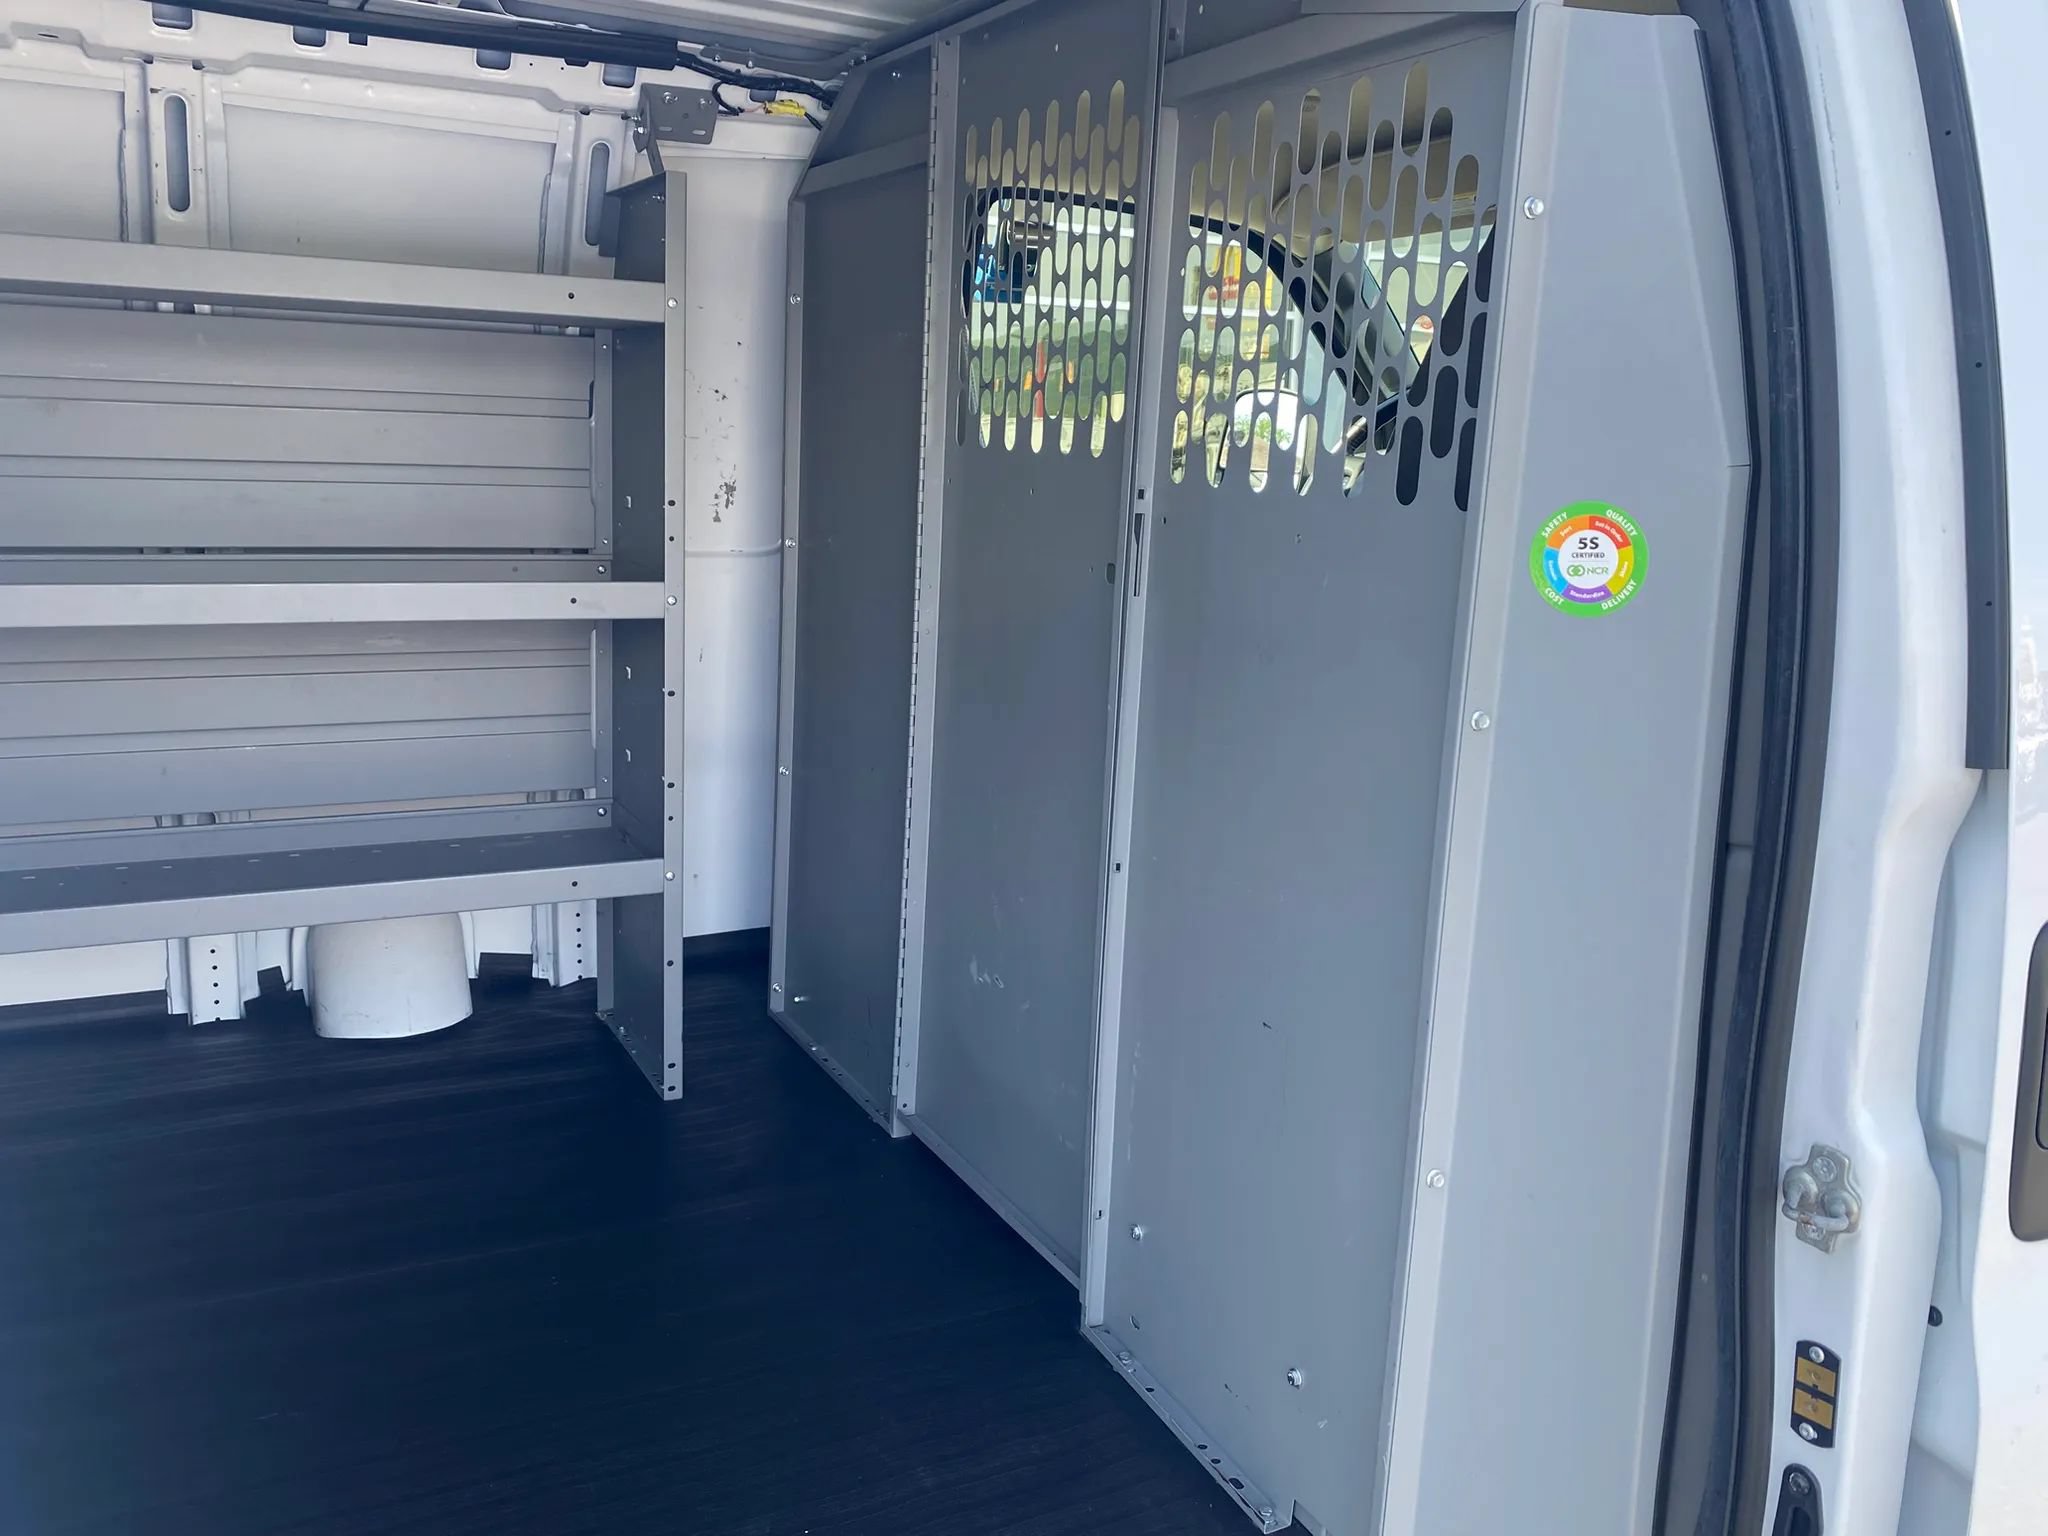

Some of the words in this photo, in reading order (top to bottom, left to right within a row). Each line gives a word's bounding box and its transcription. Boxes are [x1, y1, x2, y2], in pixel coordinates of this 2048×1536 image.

[1541, 511, 1568, 538] SAFETY
[1605, 509, 1638, 537] QUALITY
[1577, 536, 1600, 550] 5S
[1586, 566, 1609, 575] NCR
[1544, 587, 1565, 606] COST
[1601, 578, 1638, 610] DELIVERY
